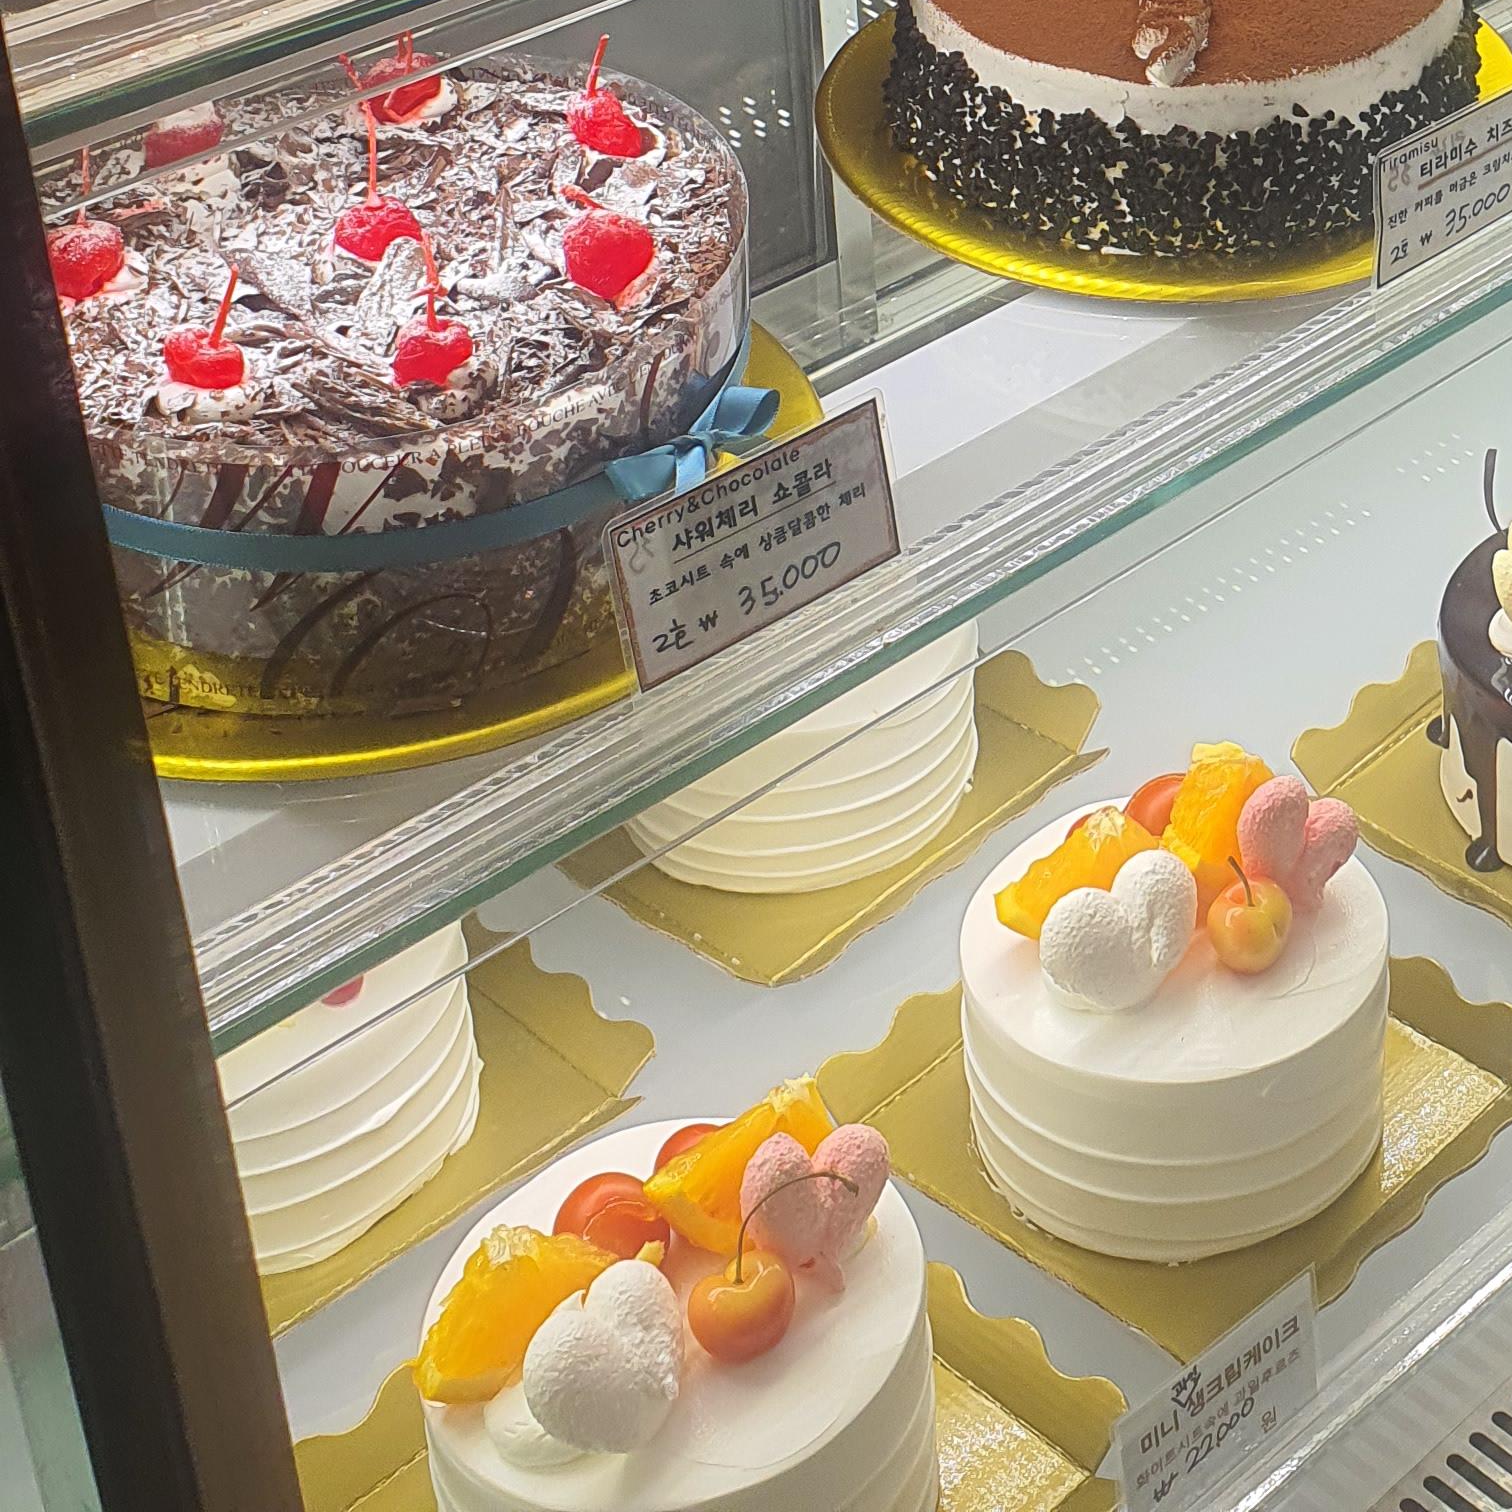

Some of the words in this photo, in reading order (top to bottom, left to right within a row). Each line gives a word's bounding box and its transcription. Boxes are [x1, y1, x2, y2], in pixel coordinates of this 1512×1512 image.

[1381, 137, 1439, 173] Tiramisu
[1420, 138, 1478, 178] 티라미수
[1388, 209, 1408, 230] 진한
[1390, 238, 1409, 266] 2호
[672, 495, 758, 552] 샤워체리
[772, 458, 833, 506] 쇼콜라
[649, 563, 711, 606] 초코시트
[719, 542, 749, 571] 속에
[758, 505, 831, 552] 상큼달콤한
[838, 482, 866, 507] 체리
[652, 618, 694, 653] 2호
[1140, 1409, 1179, 1454] 미니
[1187, 1315, 1301, 1417] 생크림케이크
[1260, 1405, 1277, 1434] 원
